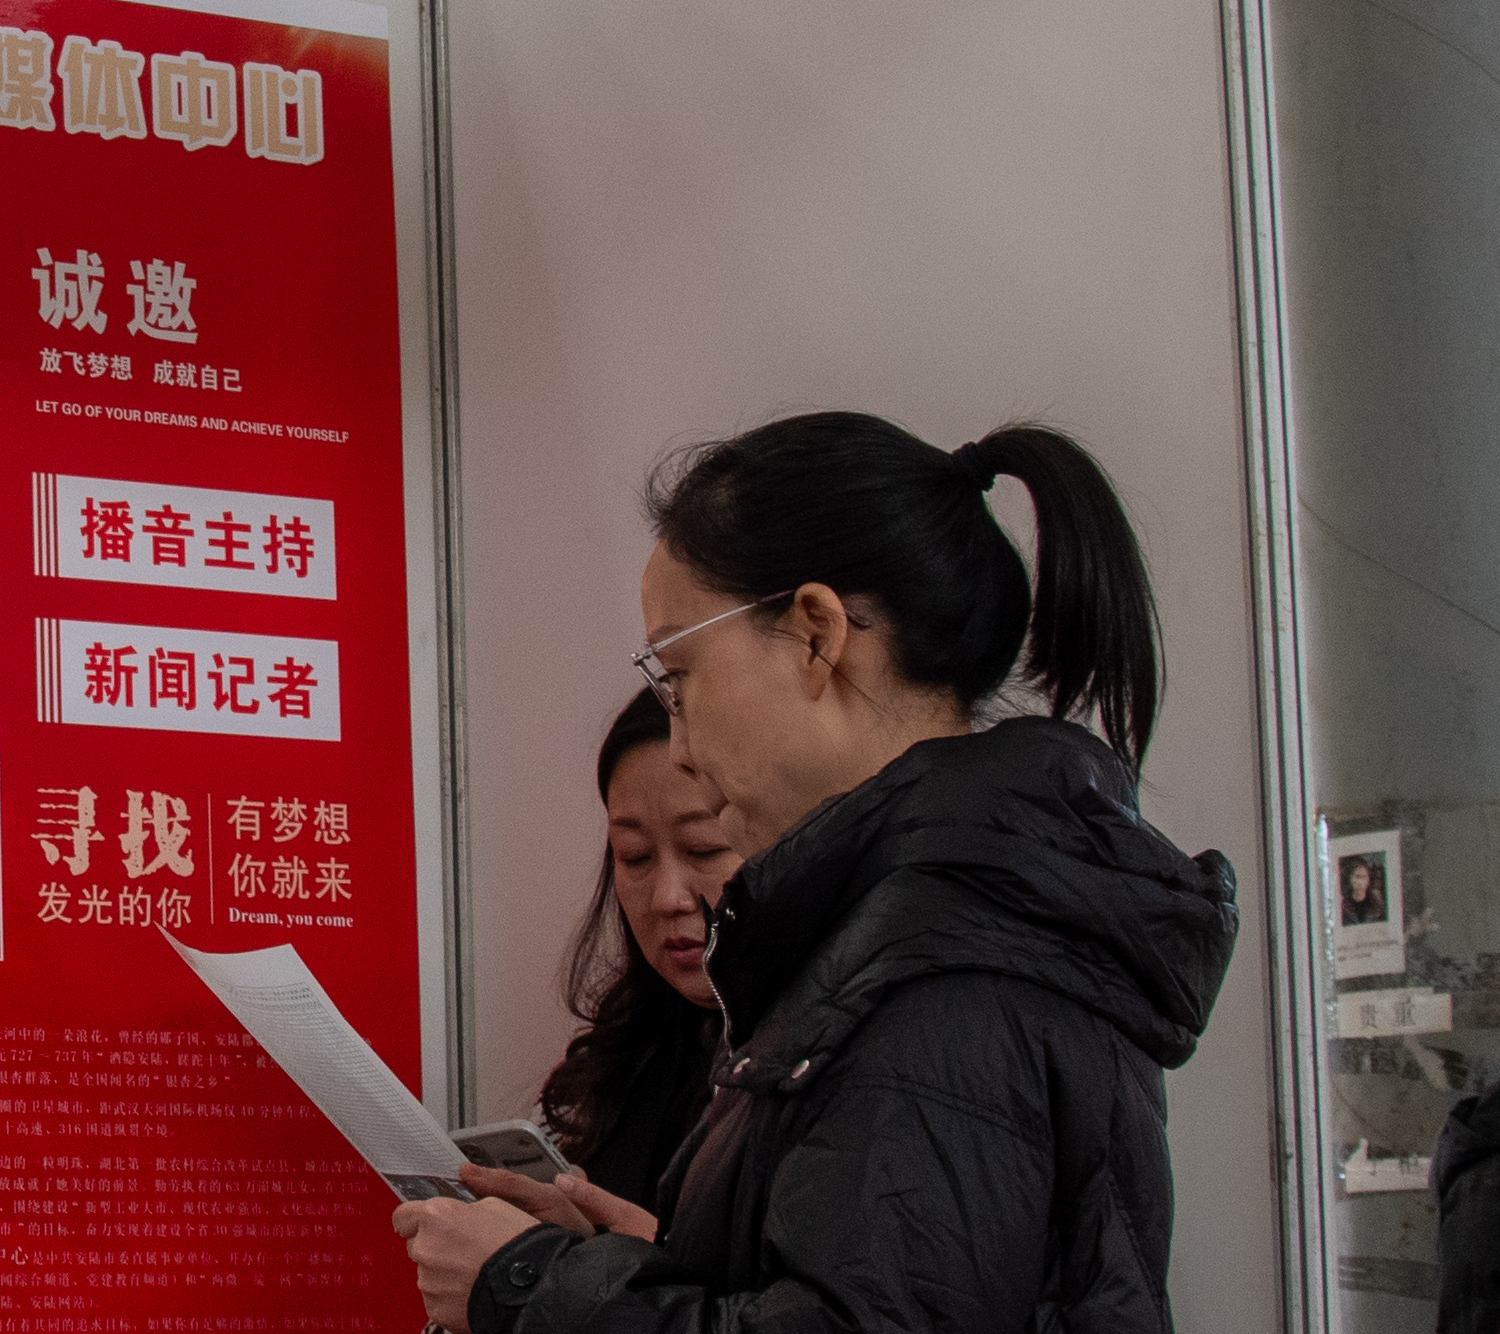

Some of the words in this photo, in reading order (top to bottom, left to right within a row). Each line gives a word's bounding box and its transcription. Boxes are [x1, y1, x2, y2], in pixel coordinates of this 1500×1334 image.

[31, 247, 200, 344] 诚邀
[40, 347, 133, 380] 放飞梦想
[154, 360, 243, 393] 成就自己
[35, 399, 58, 415] LET
[61, 403, 82, 417] GO
[85, 405, 102, 418] OF
[105, 407, 142, 422] YOUR
[144, 411, 198, 428] DREAMS
[201, 417, 228, 432] AND
[231, 420, 284, 437] ACHIEVE
[286, 425, 349, 443] YOURSELF
[80, 497, 316, 579] 播音主持
[84, 643, 320, 720] 新闻记者
[31, 786, 196, 876] 寻找
[227, 795, 351, 845] 有梦想
[228, 852, 353, 902] 你就来
[37, 882, 192, 929] 发光的你
[228, 907, 284, 926] Dream,
[286, 913, 313, 928] you
[316, 916, 354, 928] come
